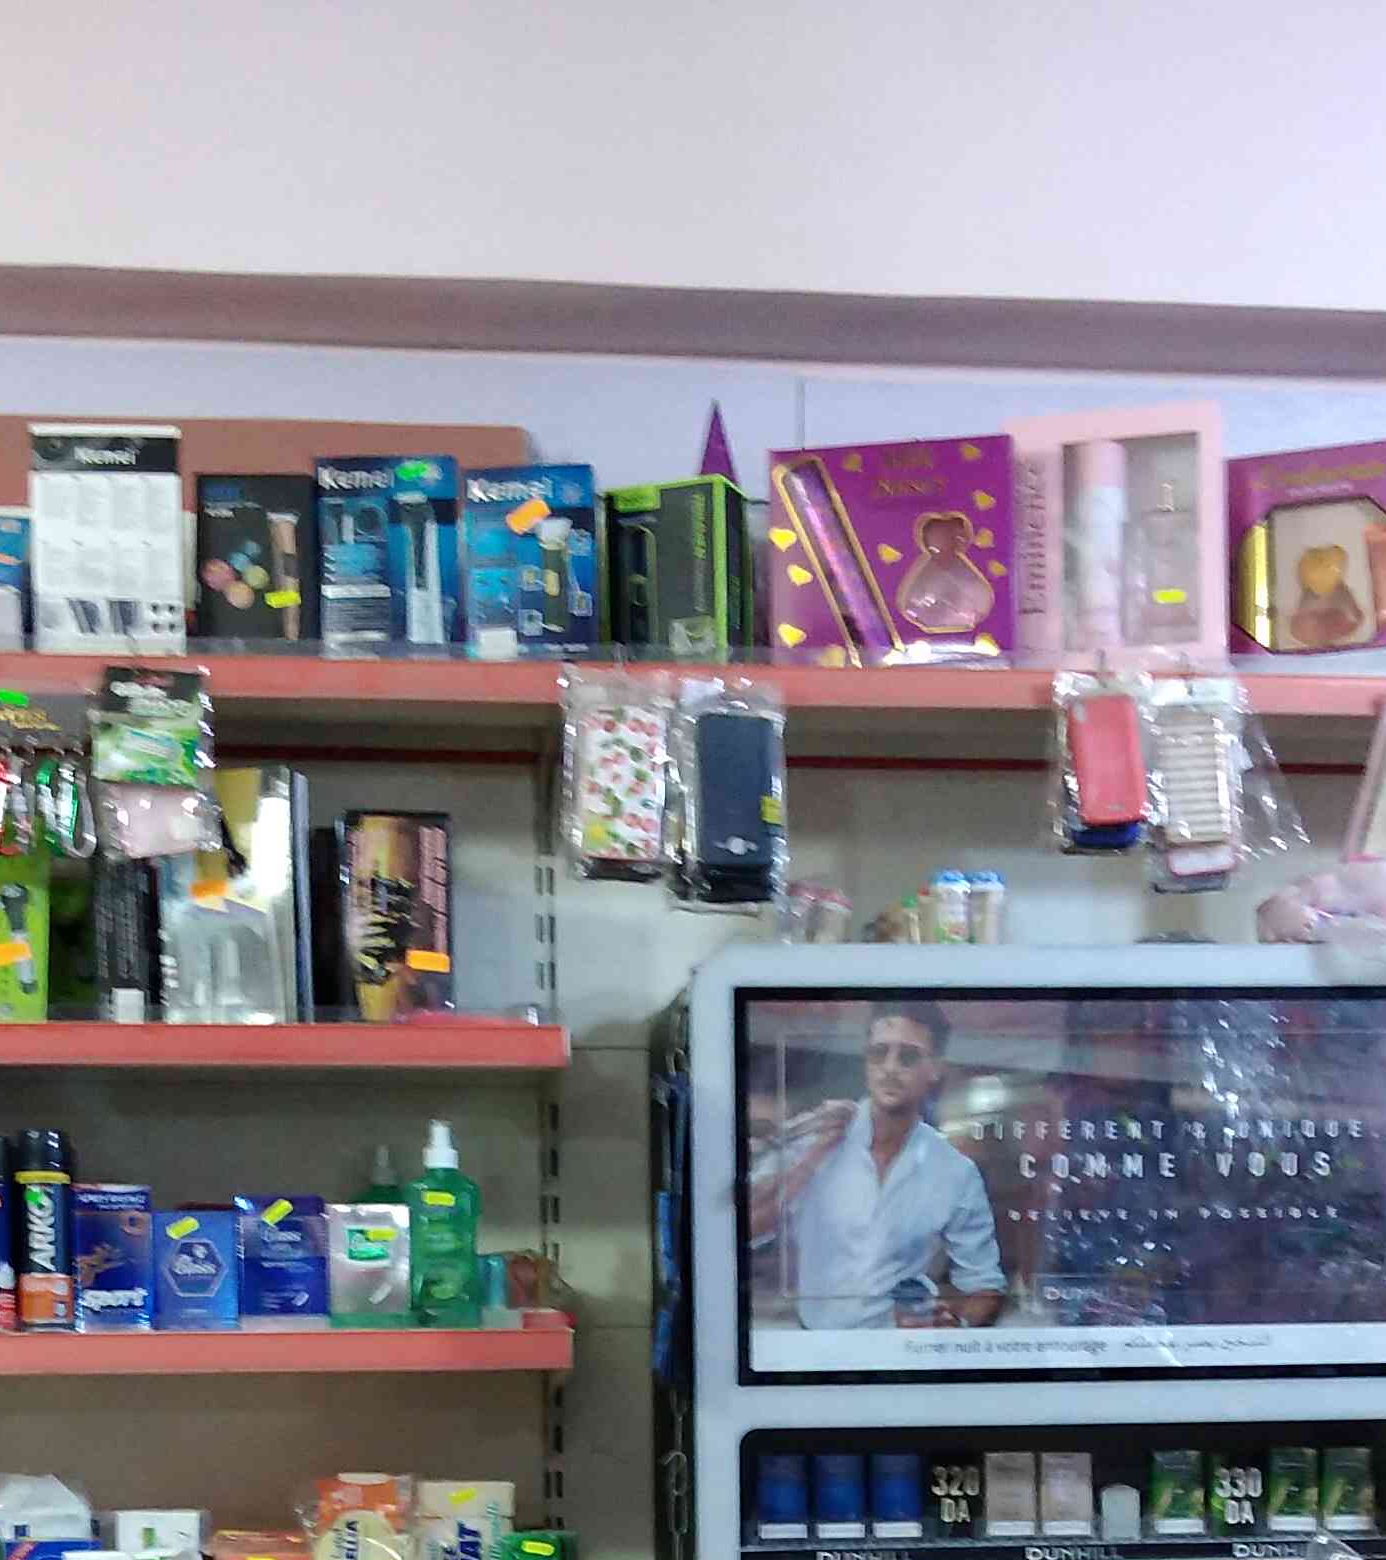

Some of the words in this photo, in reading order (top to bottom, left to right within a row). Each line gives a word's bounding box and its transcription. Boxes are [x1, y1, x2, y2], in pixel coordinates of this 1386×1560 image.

[74, 447, 136, 466] Kemei
[317, 465, 395, 489] Kemei
[466, 476, 554, 503] Kemei
[1019, 1152, 1176, 1179] COMME
[1216, 1150, 1332, 1178] VOUS
[26, 1184, 56, 1272] ARKO
[955, 1338, 983, 1354] nuit
[1036, 1339, 1108, 1357] entourage
[931, 1465, 981, 1497] 320
[1214, 1466, 1263, 1498] 330
[939, 1498, 972, 1523] DA
[1223, 1500, 1255, 1524] DA
